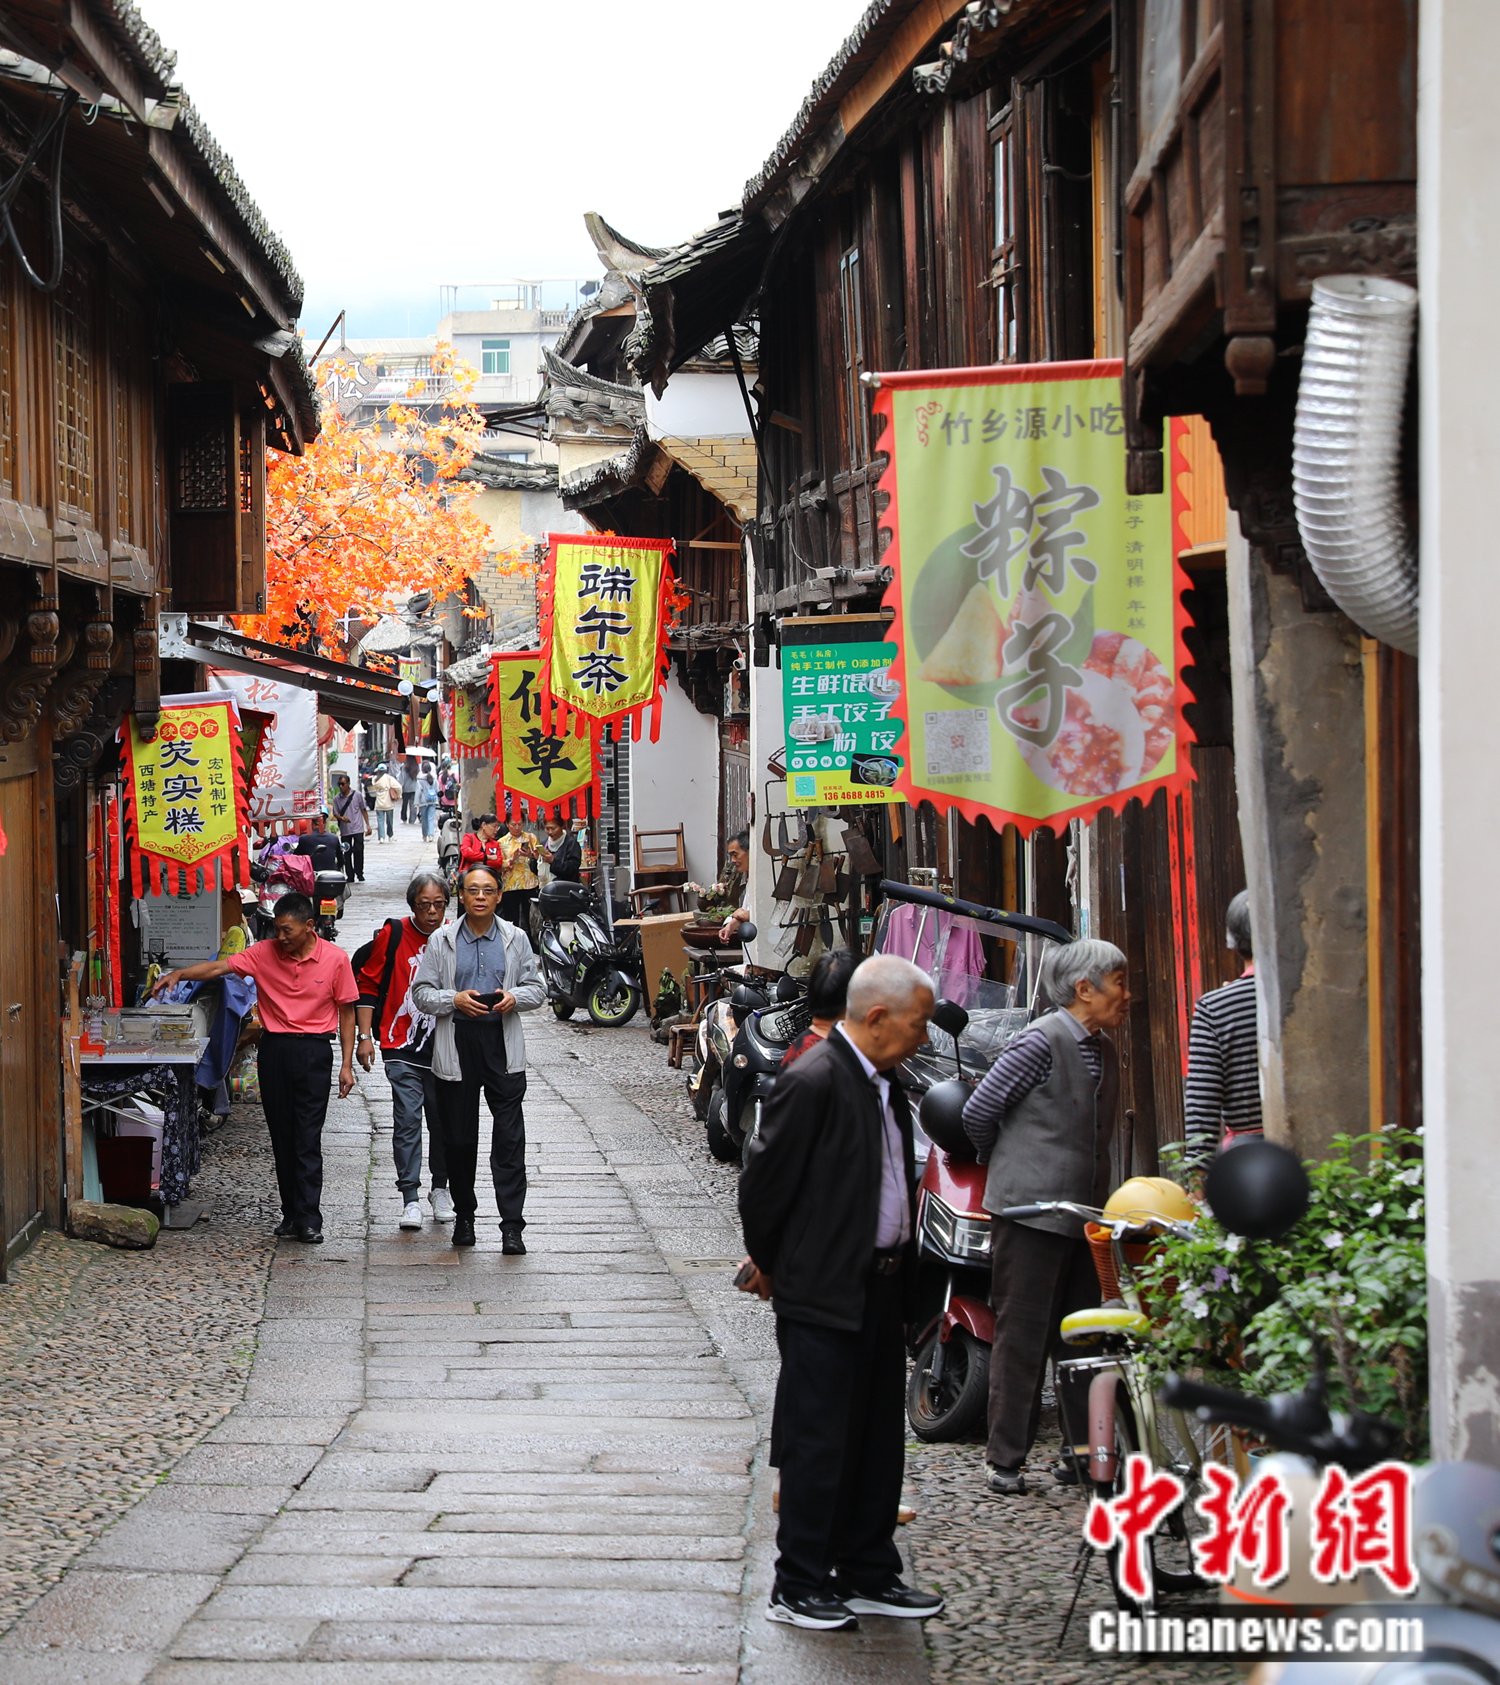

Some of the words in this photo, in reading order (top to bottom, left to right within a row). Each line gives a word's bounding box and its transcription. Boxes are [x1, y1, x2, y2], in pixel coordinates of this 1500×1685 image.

[940, 402, 1124, 446] 竹乡源小吃
[959, 464, 1101, 749] 粽子
[572, 563, 637, 695] 端午茶
[790, 660, 847, 671] 纯手工制作
[791, 673, 893, 696] 生鲜馄饨
[141, 719, 219, 744] 统美食
[792, 702, 893, 724] 手工饺子
[138, 763, 159, 823] 西塘特产
[159, 739, 206, 836] 芡实糕
[207, 757, 228, 816] 宏记制作
[823, 792, 839, 801] 136
[841, 791, 863, 800] 4688
[865, 790, 885, 799] 4815
